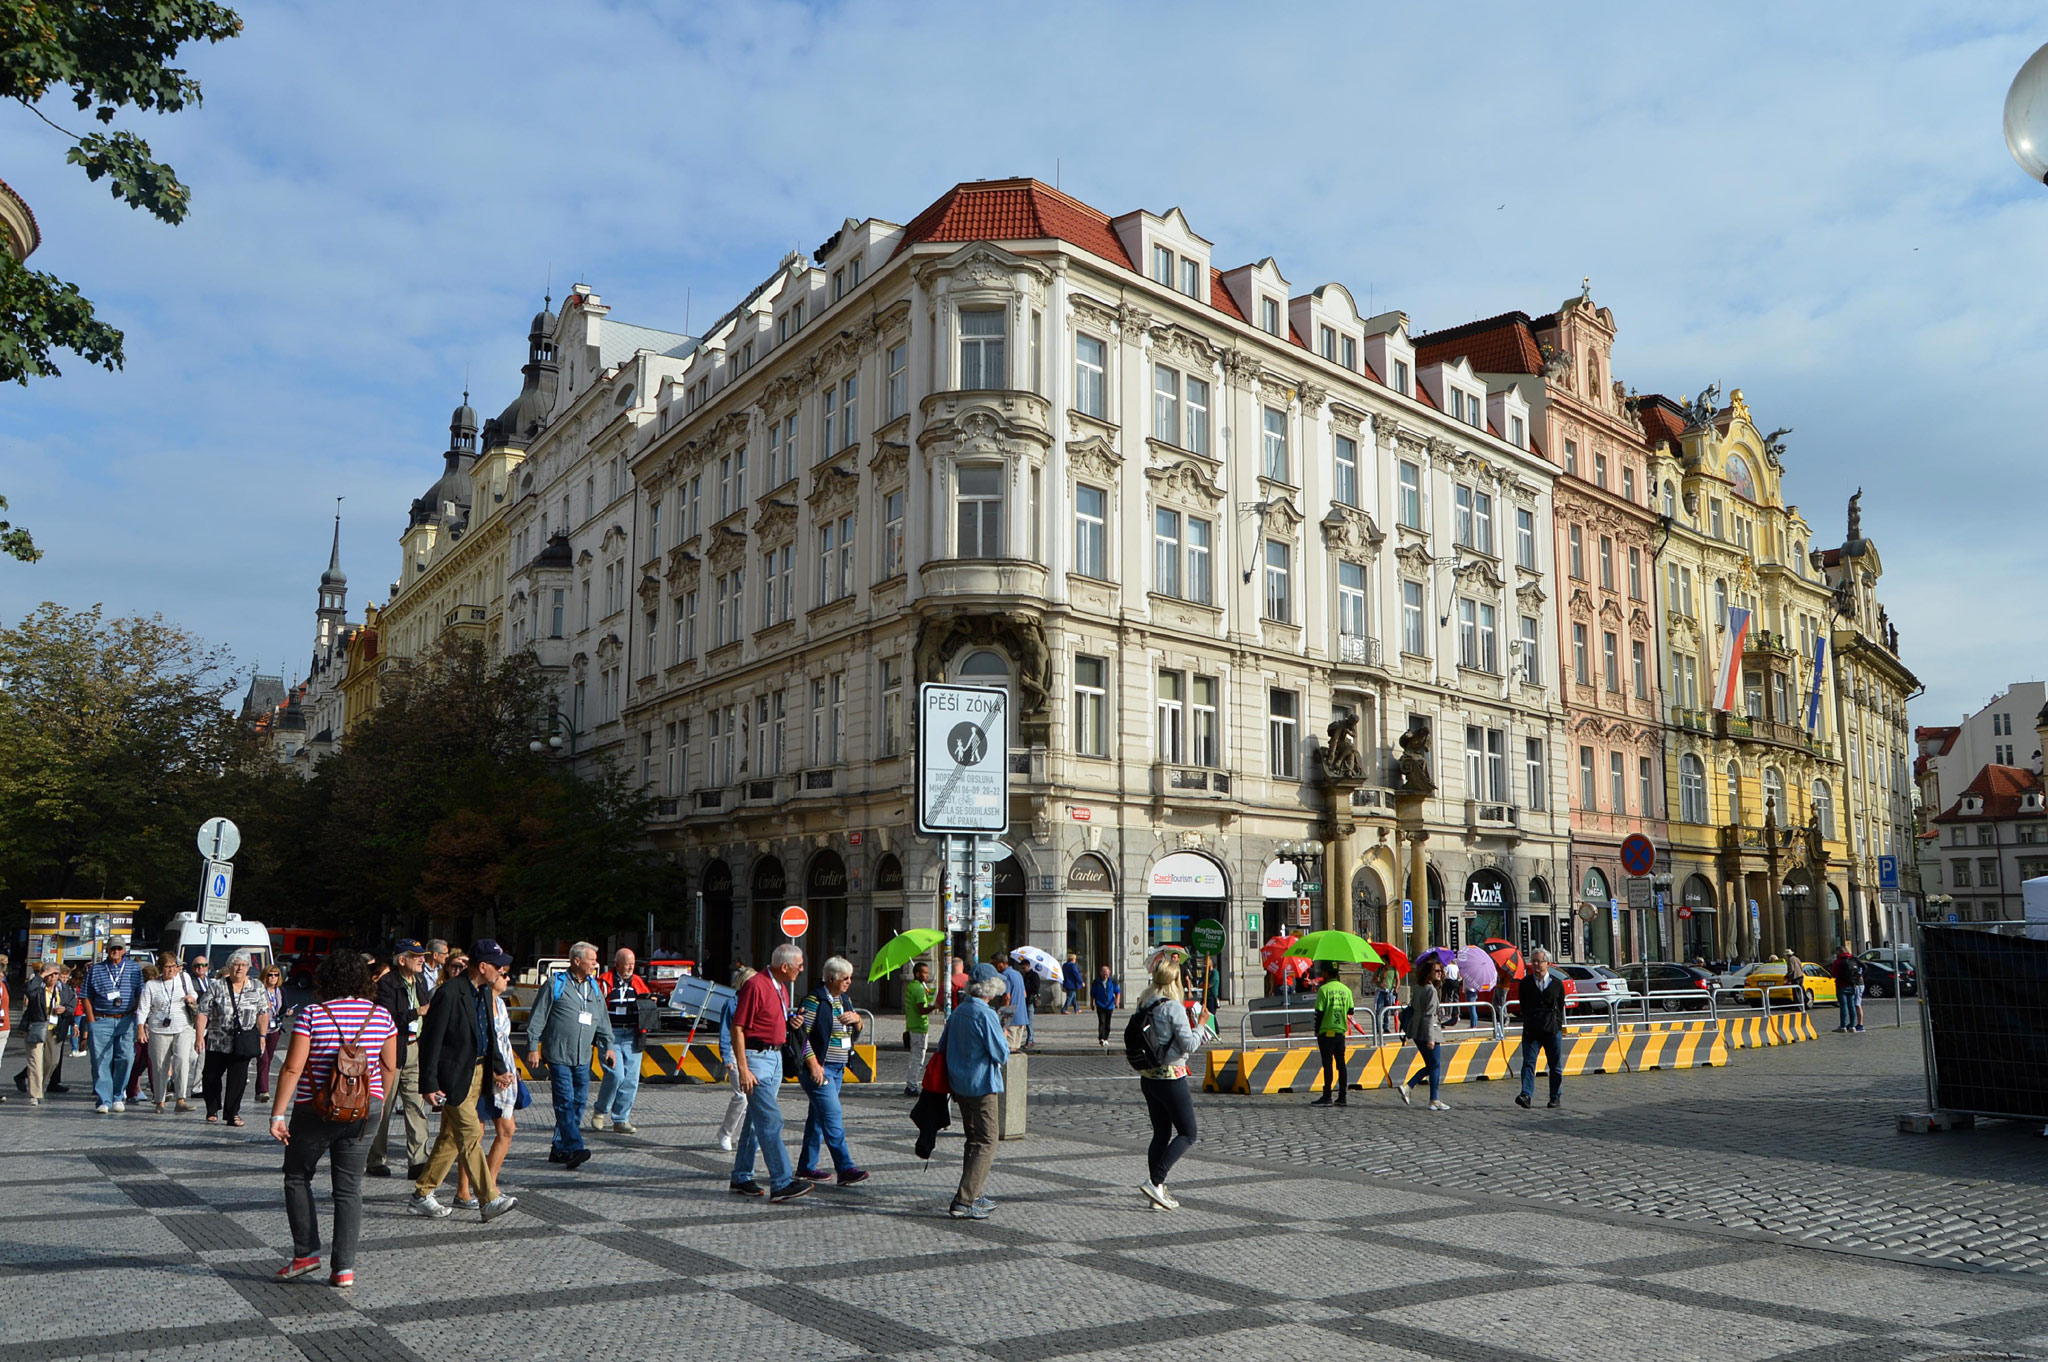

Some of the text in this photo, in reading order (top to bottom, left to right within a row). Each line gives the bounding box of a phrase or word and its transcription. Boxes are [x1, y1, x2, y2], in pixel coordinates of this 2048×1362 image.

[929, 692, 1003, 714] PĚŠÍ ZÓNA
[966, 774, 994, 784] OBSLUHA
[965, 807, 1000, 817] SOUHLASEM
[958, 817, 978, 826] PRAHA
[1070, 866, 1105, 882] Cartier
[1882, 859, 1893, 879] P
[758, 872, 785, 890] Cartier
[814, 867, 846, 886] Cartier
[1153, 873, 1193, 883] CzechTourism
[1586, 887, 1605, 897] OMEGA
[220, 926, 250, 935] TOURS
[1205, 933, 1222, 941] Tours
